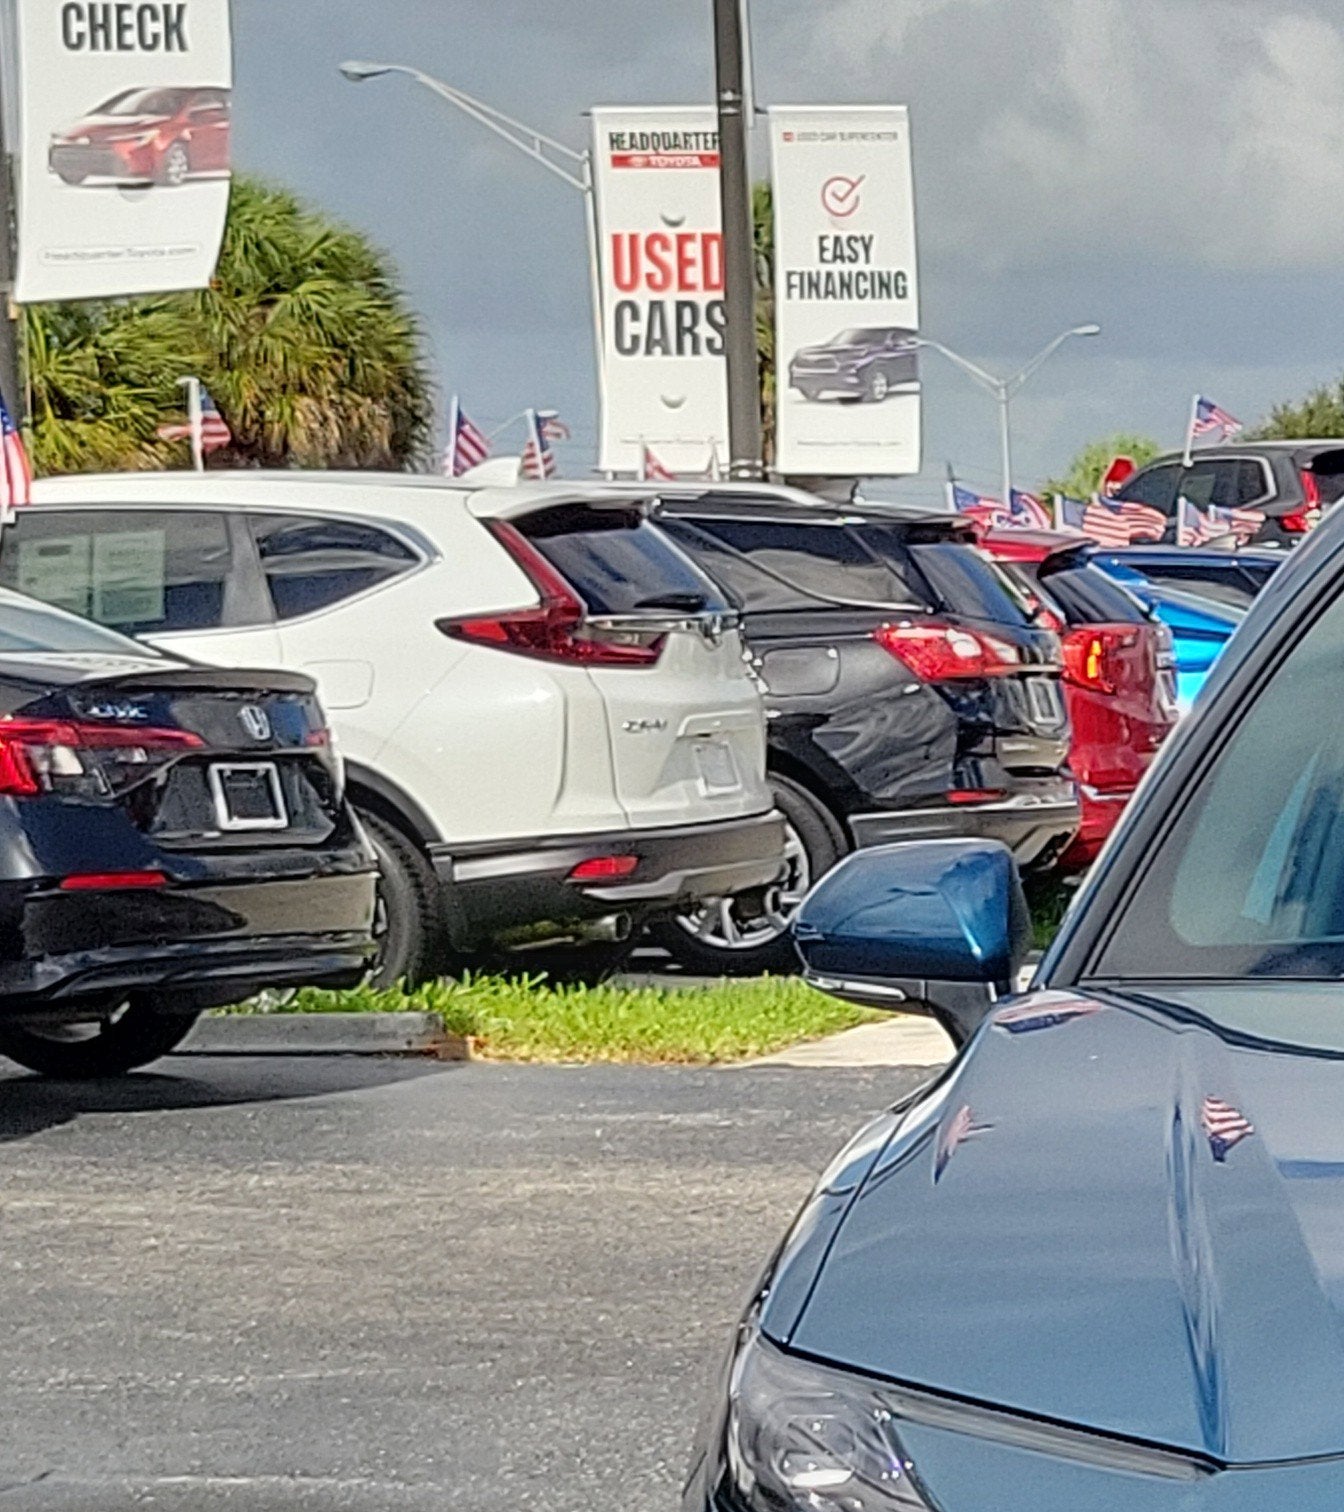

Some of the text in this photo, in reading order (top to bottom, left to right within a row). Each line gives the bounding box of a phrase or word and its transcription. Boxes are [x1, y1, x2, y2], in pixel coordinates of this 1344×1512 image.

[62, 2, 188, 52] CHECK
[611, 232, 725, 292] USED
[818, 234, 874, 264] EASY
[785, 270, 908, 300] FINANCING
[614, 299, 728, 356] CARS
